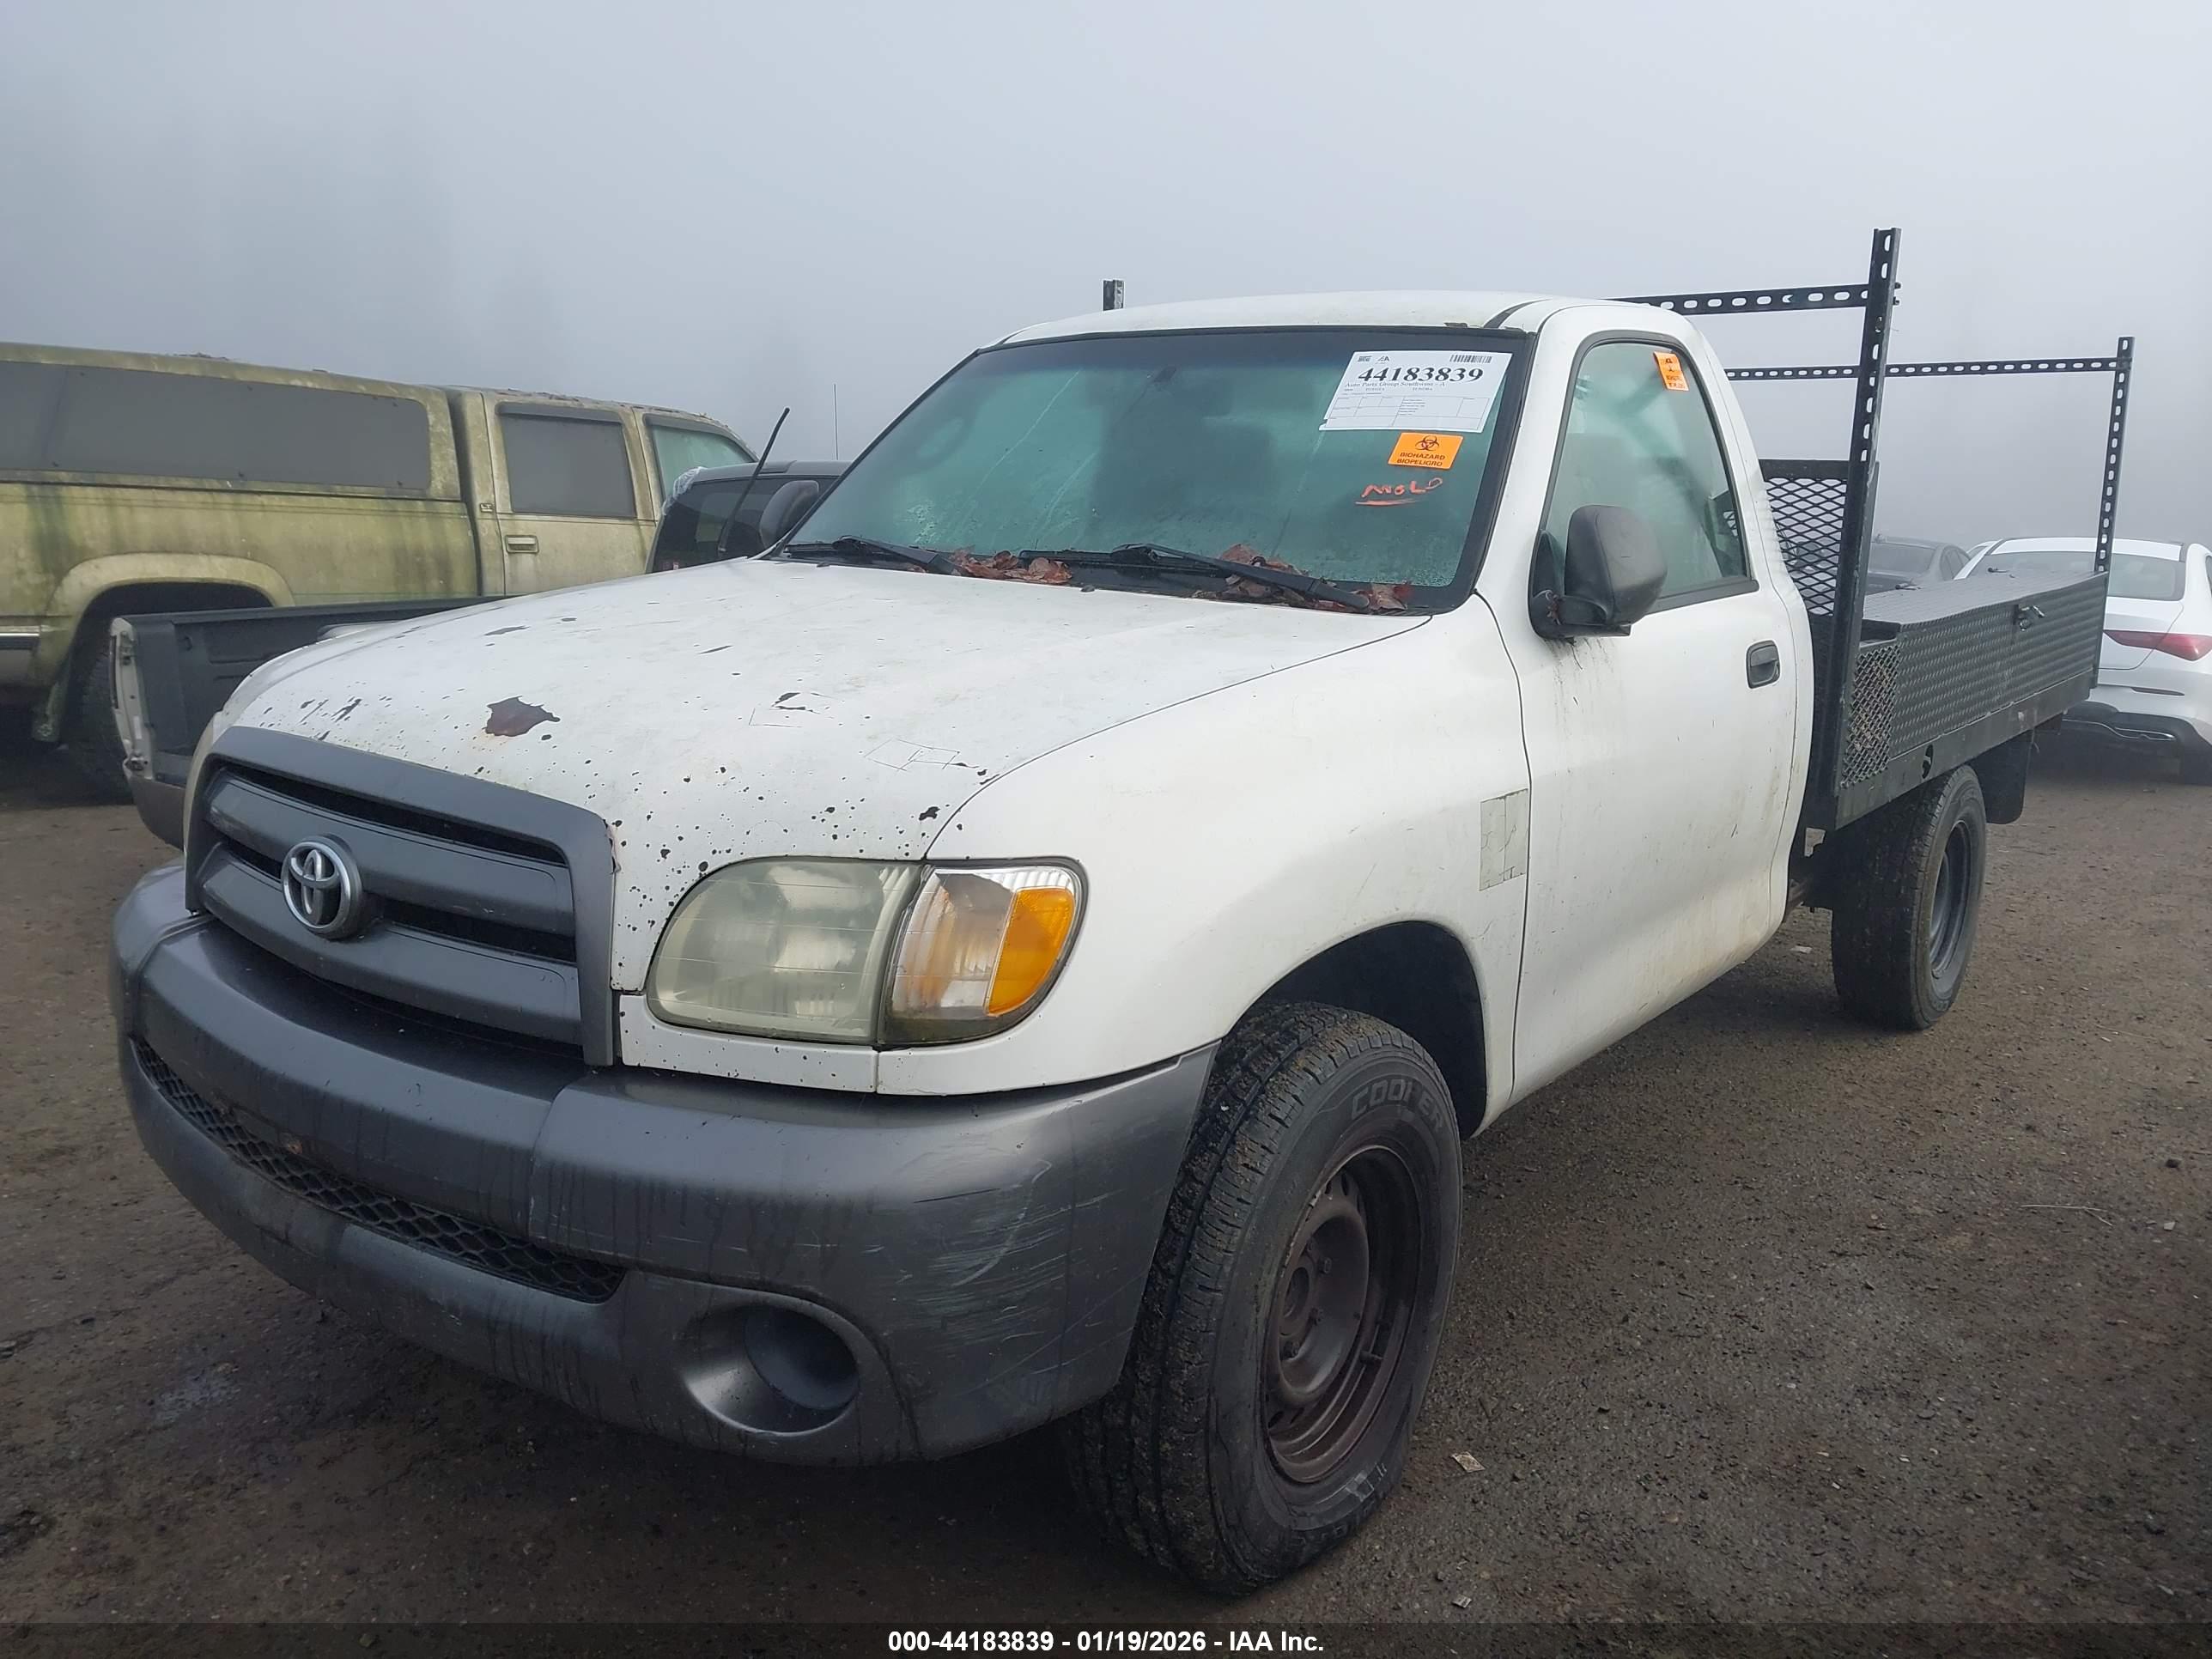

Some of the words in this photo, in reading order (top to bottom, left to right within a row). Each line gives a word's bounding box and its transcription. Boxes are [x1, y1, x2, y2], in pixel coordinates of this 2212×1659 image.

[1358, 367, 1484, 383] 44183839
[1400, 452, 1446, 460] BIOHAZARD
[1396, 458, 1443, 467] BIOPELIGRO
